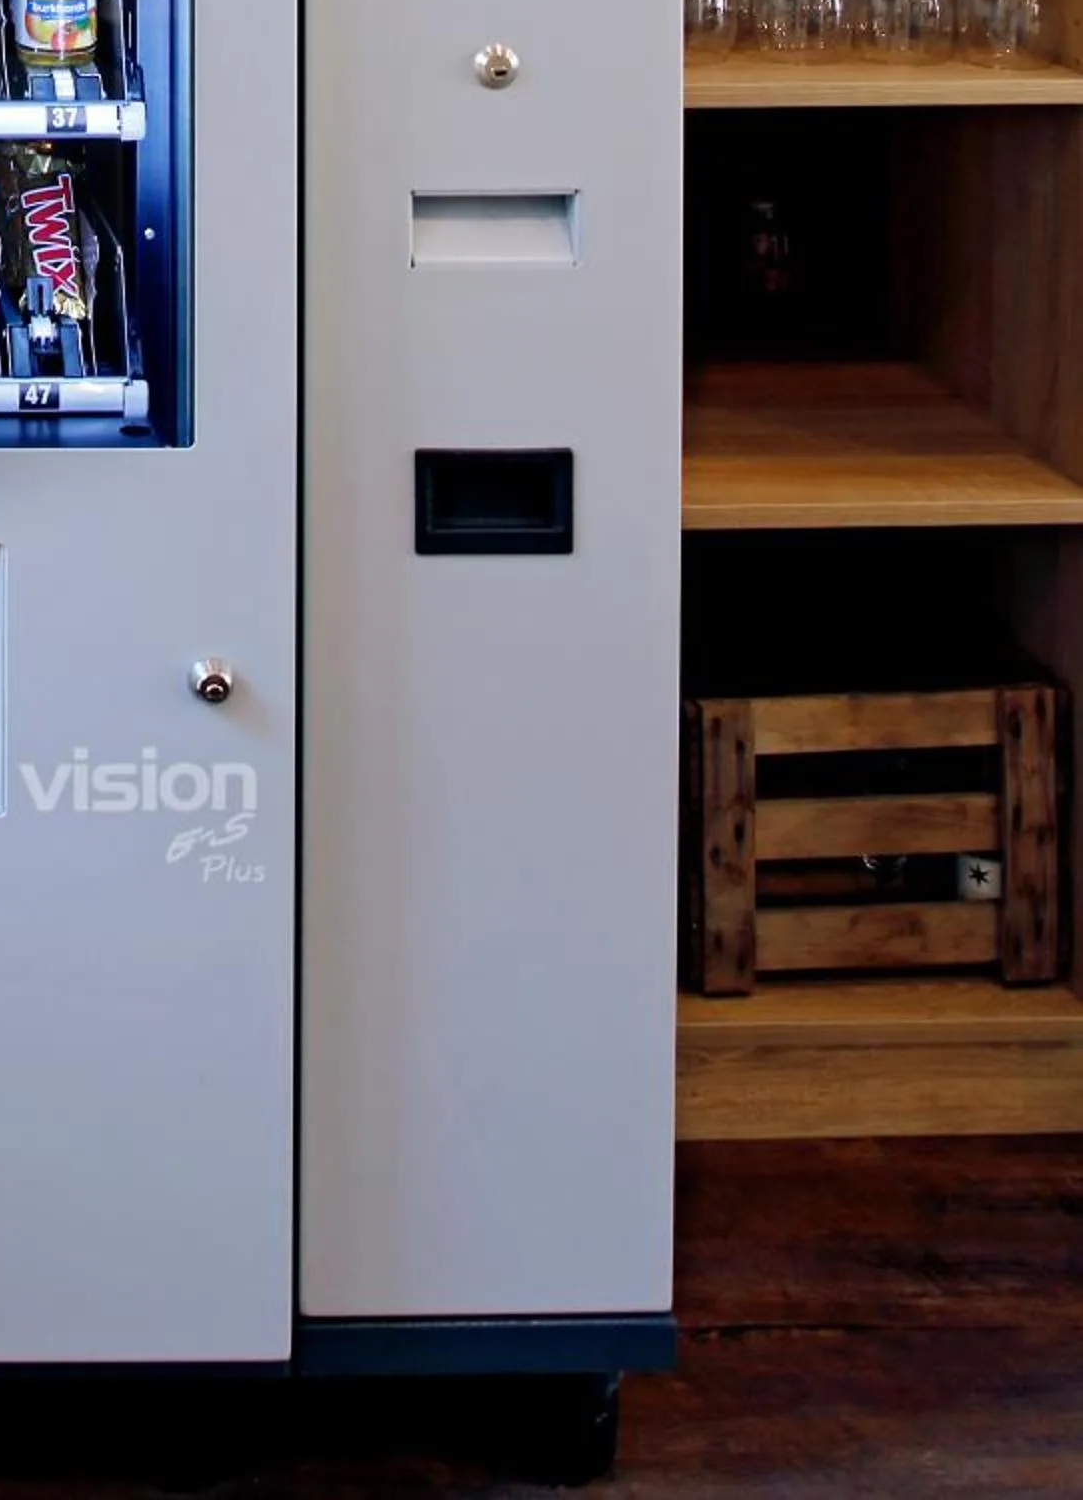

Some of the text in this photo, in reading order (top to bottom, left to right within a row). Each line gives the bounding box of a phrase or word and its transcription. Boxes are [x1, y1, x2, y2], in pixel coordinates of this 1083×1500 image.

[52, 107, 77, 127] 37
[25, 385, 50, 404] 47
[17, 746, 258, 812] vision
[198, 853, 266, 883] Plus
